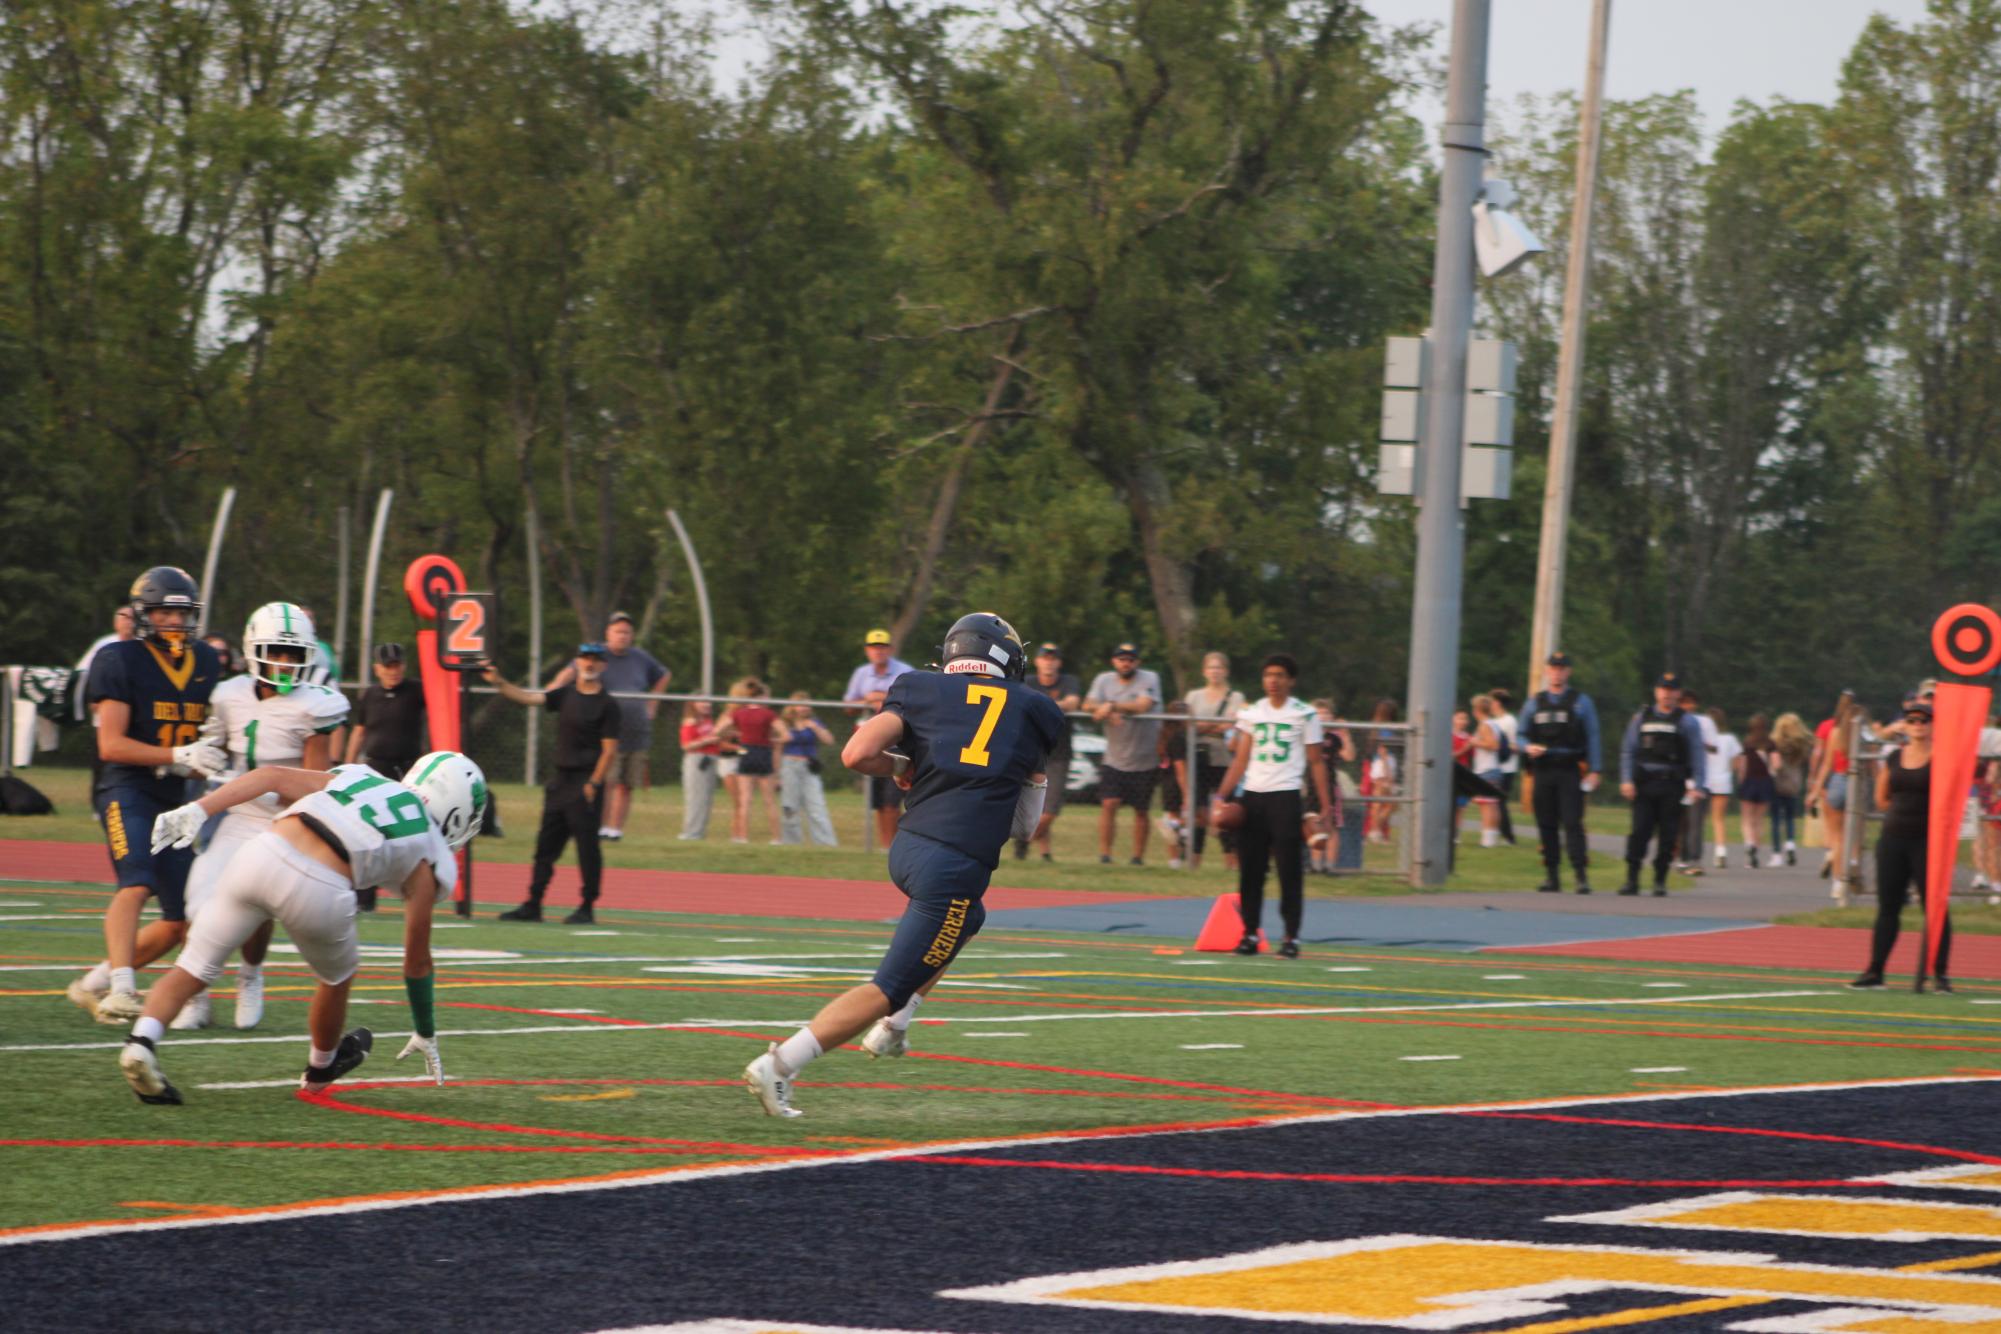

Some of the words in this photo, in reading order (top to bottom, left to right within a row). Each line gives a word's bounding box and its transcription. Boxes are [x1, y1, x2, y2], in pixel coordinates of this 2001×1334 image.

[448, 599, 484, 652] 2
[949, 662, 987, 673] Riddell
[244, 719, 260, 769] 1
[960, 684, 1008, 767] 7
[327, 773, 430, 840] 19
[923, 899, 970, 967] TERRIERS
